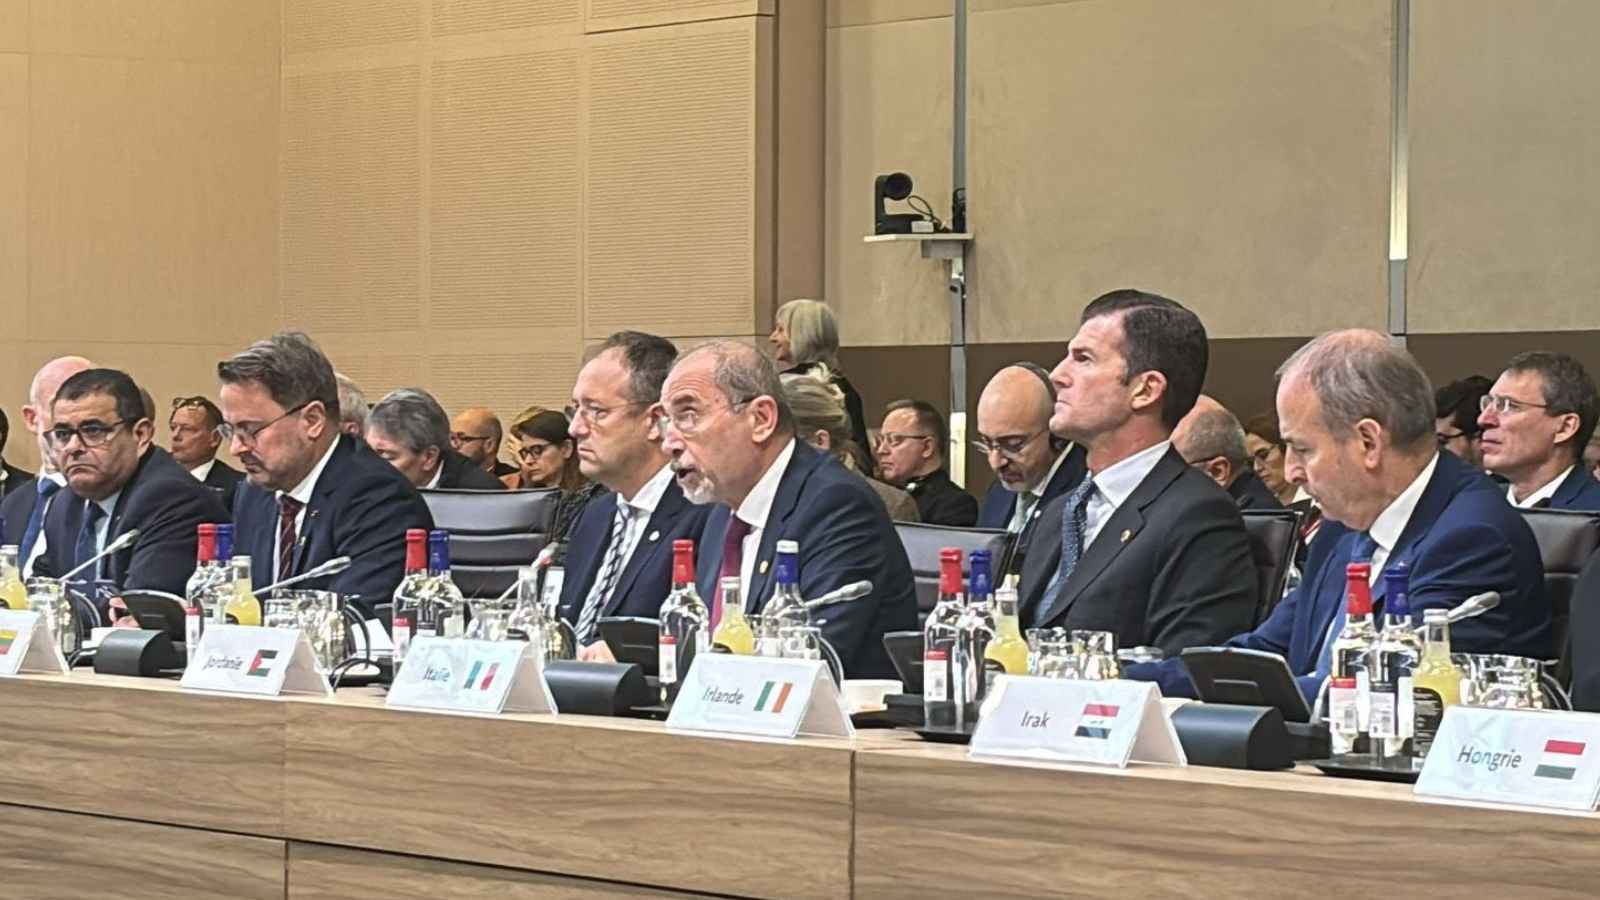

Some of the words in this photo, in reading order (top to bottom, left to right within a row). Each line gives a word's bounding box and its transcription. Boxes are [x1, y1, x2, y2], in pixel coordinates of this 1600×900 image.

[702, 685, 744, 705] Irlande
[1020, 710, 1050, 728] Irak
[1456, 744, 1522, 772] Hongrie
